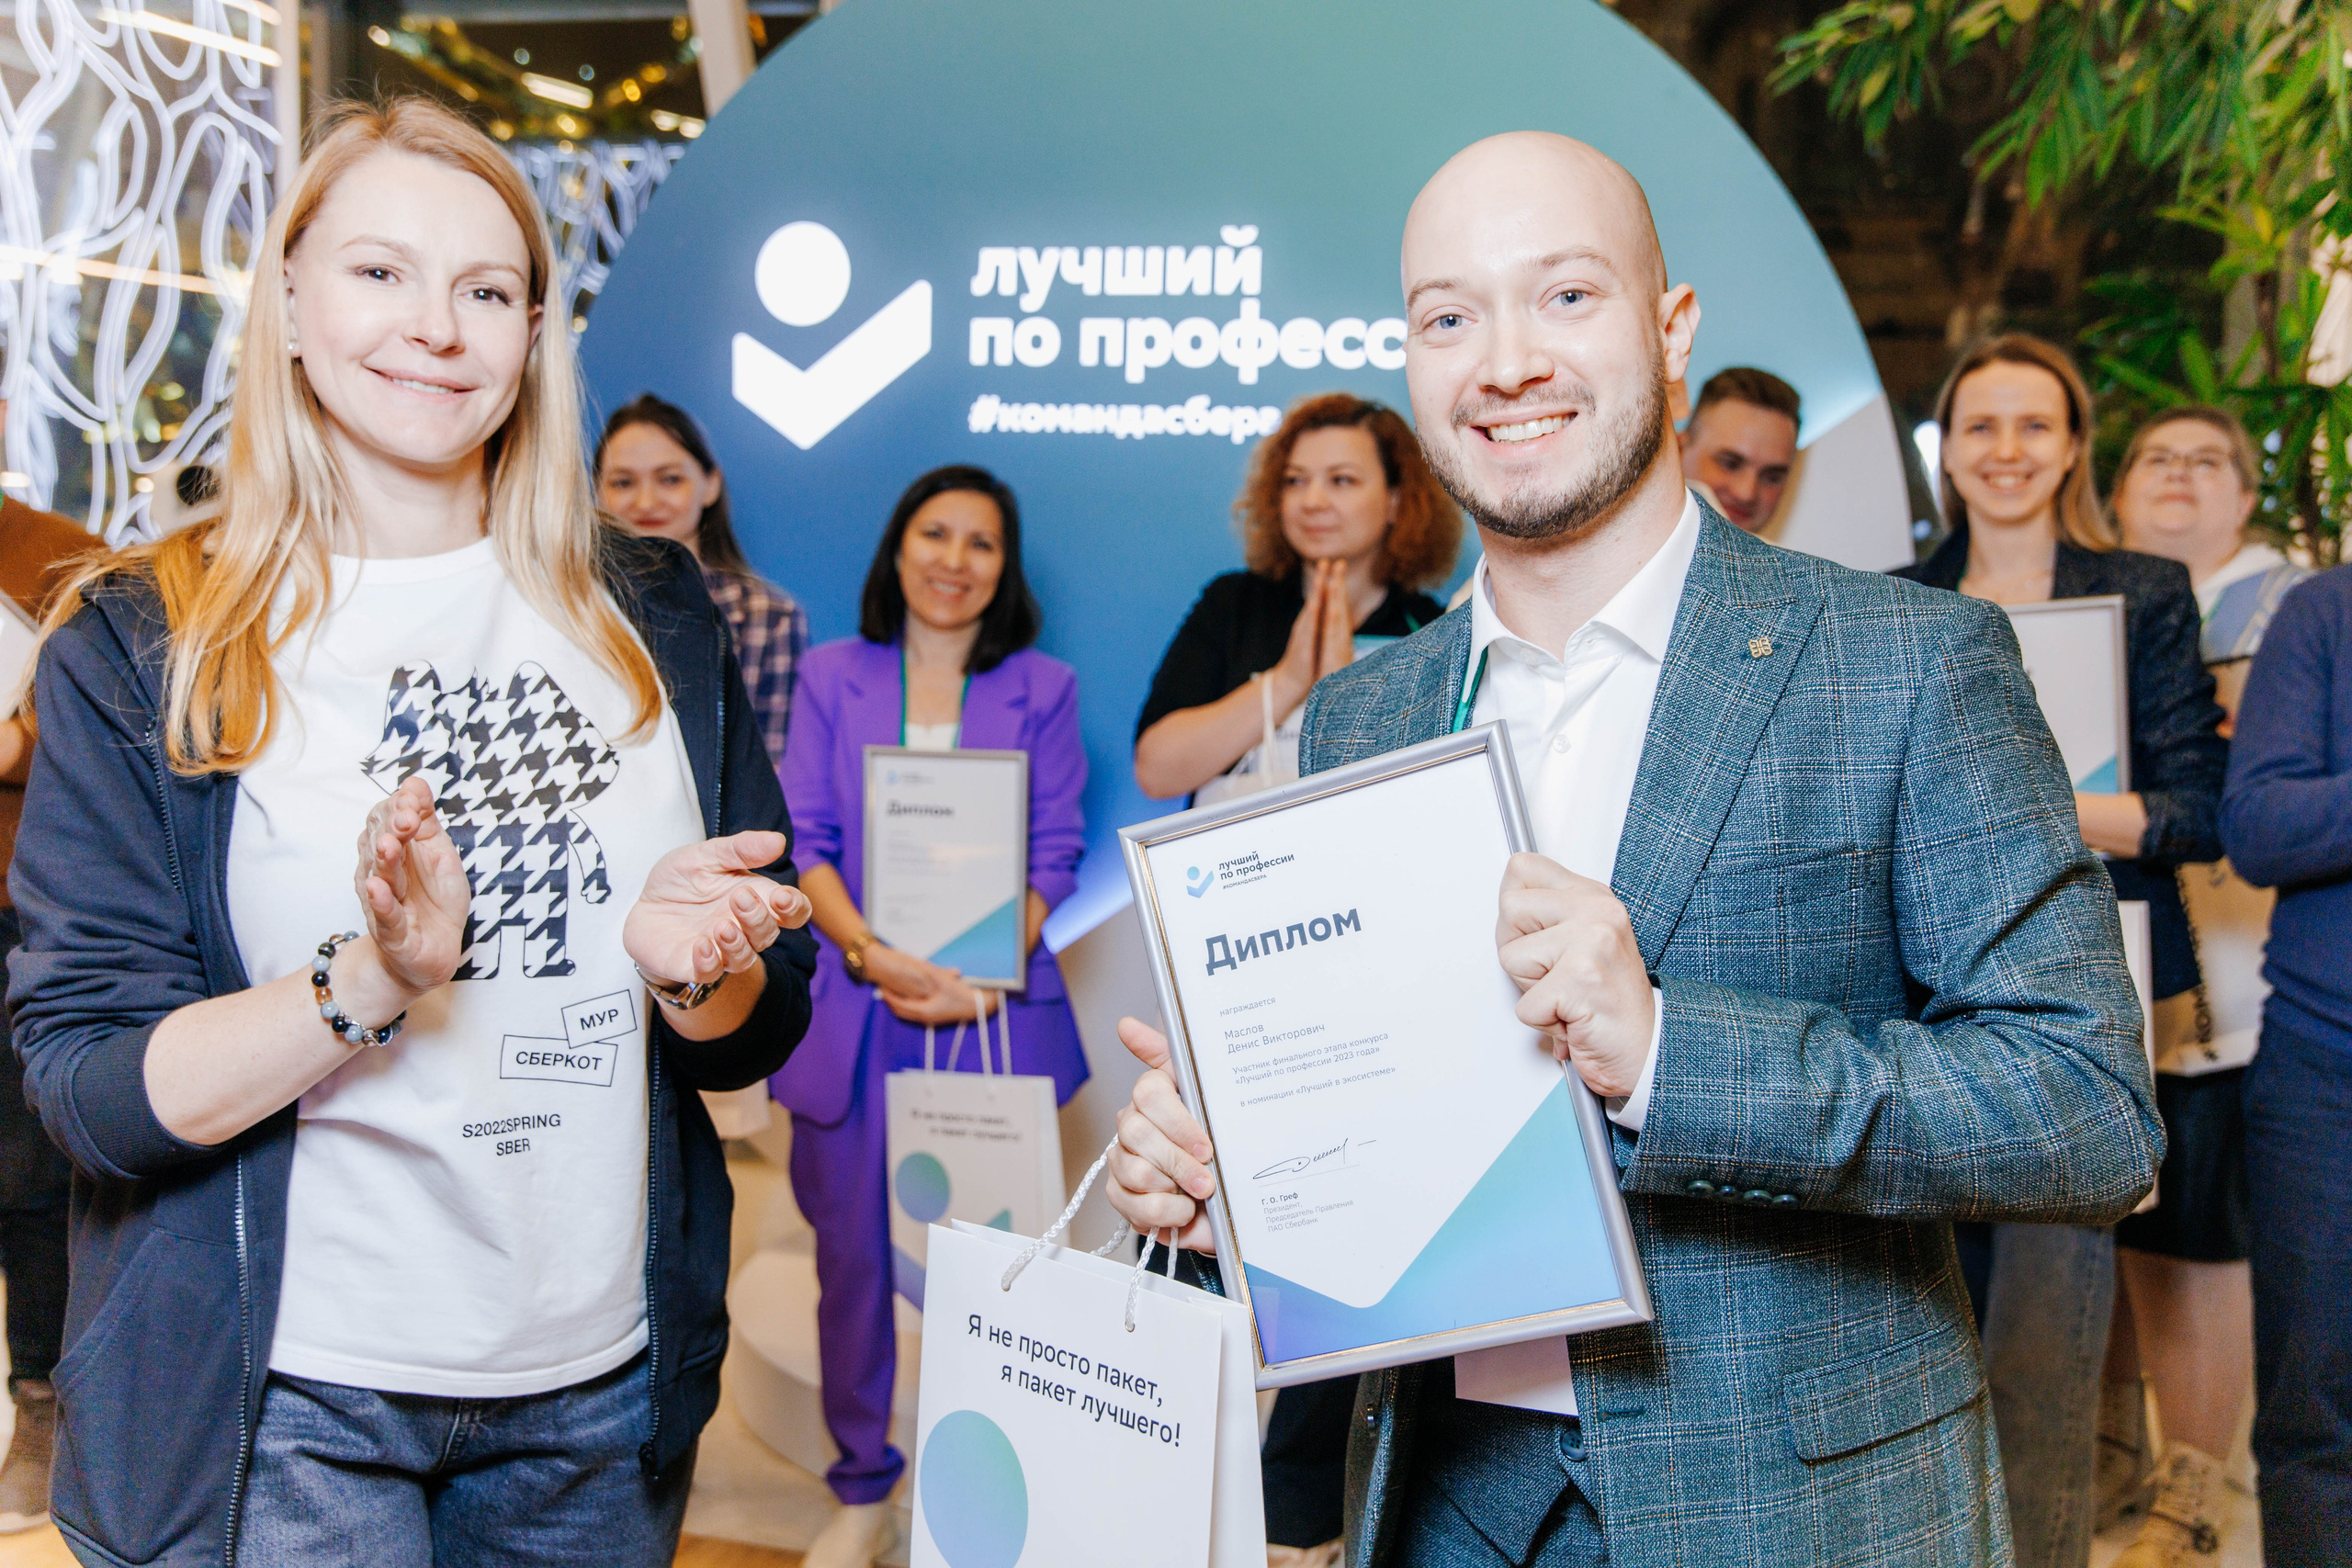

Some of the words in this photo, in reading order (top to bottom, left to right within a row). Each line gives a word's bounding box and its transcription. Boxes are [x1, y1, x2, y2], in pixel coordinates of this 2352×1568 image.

[970, 225, 1262, 312] лучший
[969, 317, 1061, 367] по
[1080, 298, 1407, 384] професс
[1218, 851, 1260, 870] лучший
[1220, 870, 1234, 880] по
[1236, 853, 1295, 876] профессии
[1223, 874, 1267, 889] #КОМАНДАСБЕРА
[1204, 908, 1363, 976] Диплом
[1219, 997, 1276, 1017] награждается
[580, 1009, 618, 1031] МУР
[1225, 1024, 1264, 1040] Маслов
[1227, 1039, 1260, 1055] Денис
[1262, 1023, 1326, 1045] Викторович
[515, 1051, 603, 1071] СБЕРКОТ
[1232, 1060, 1271, 1075] Участник
[1272, 1048, 1322, 1066] финального
[1324, 1043, 1348, 1055] этапа
[1349, 1032, 1389, 1049] конкурса
[1235, 1070, 1272, 1085] «Лучший
[1274, 1068, 1284, 1077] по
[1286, 1058, 1332, 1076] профессии
[1334, 1052, 1354, 1063] 2023
[1356, 1046, 1380, 1060] года»
[1248, 1089, 1294, 1106] номинации
[1295, 1079, 1333, 1095] «Лучший
[1342, 1066, 1396, 1085] экосистеме»
[462, 1113, 561, 1138] S2022SPRING
[496, 1138, 530, 1156] SBER
[1263, 1201, 1303, 1215] Президент,
[1279, 1192, 1298, 1202] Греф
[1265, 1209, 1314, 1224] Председатель
[1315, 1200, 1354, 1213] Правления
[1268, 1224, 1283, 1233] ПАО
[1284, 1217, 1318, 1230] Сбербанк
[968, 1314, 982, 1337] Я
[989, 1325, 1012, 1348] не
[1019, 1335, 1091, 1375] просто
[1097, 1363, 1163, 1407] пакет,
[1001, 1364, 1012, 1382] я
[1018, 1370, 1077, 1405] пакет
[1081, 1393, 1181, 1447] лучшего!
